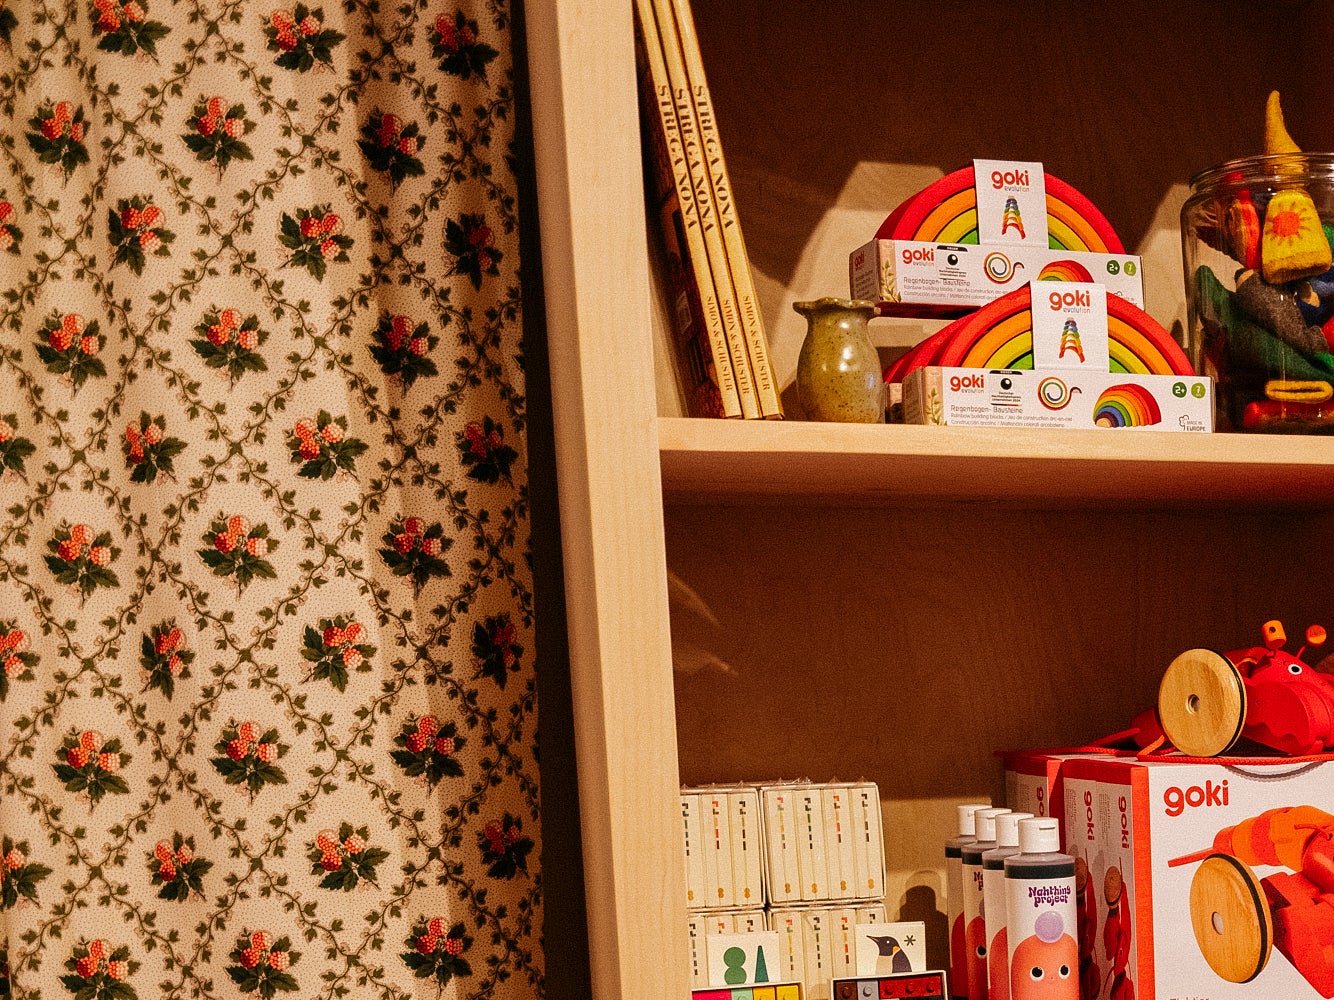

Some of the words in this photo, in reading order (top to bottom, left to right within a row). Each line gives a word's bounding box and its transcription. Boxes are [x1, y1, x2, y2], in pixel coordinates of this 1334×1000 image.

[658, 85, 683, 166] STREGA
[678, 173, 697, 229] NONA
[675, 88, 700, 169] STREGA
[695, 176, 713, 232] NONA
[694, 85, 720, 166] STREGA
[715, 173, 734, 229] NONA
[991, 169, 1030, 190] goki
[902, 248, 935, 265] goki
[1049, 290, 1091, 312] goki
[707, 296, 718, 328] SIMON
[716, 341, 733, 391] SCHUSTER
[723, 299, 736, 332] SIMON
[734, 343, 750, 395] SCHUSTER
[743, 296, 756, 328] SIMON
[753, 340, 770, 391] SCHUSTER
[950, 374, 985, 392] goki
[1036, 786, 1044, 816] go
[1084, 791, 1095, 840] goki
[1164, 779, 1229, 817] goki
[1119, 796, 1129, 849] goki
[1028, 885, 1071, 898] Nahthing
[1034, 895, 1068, 907] project
